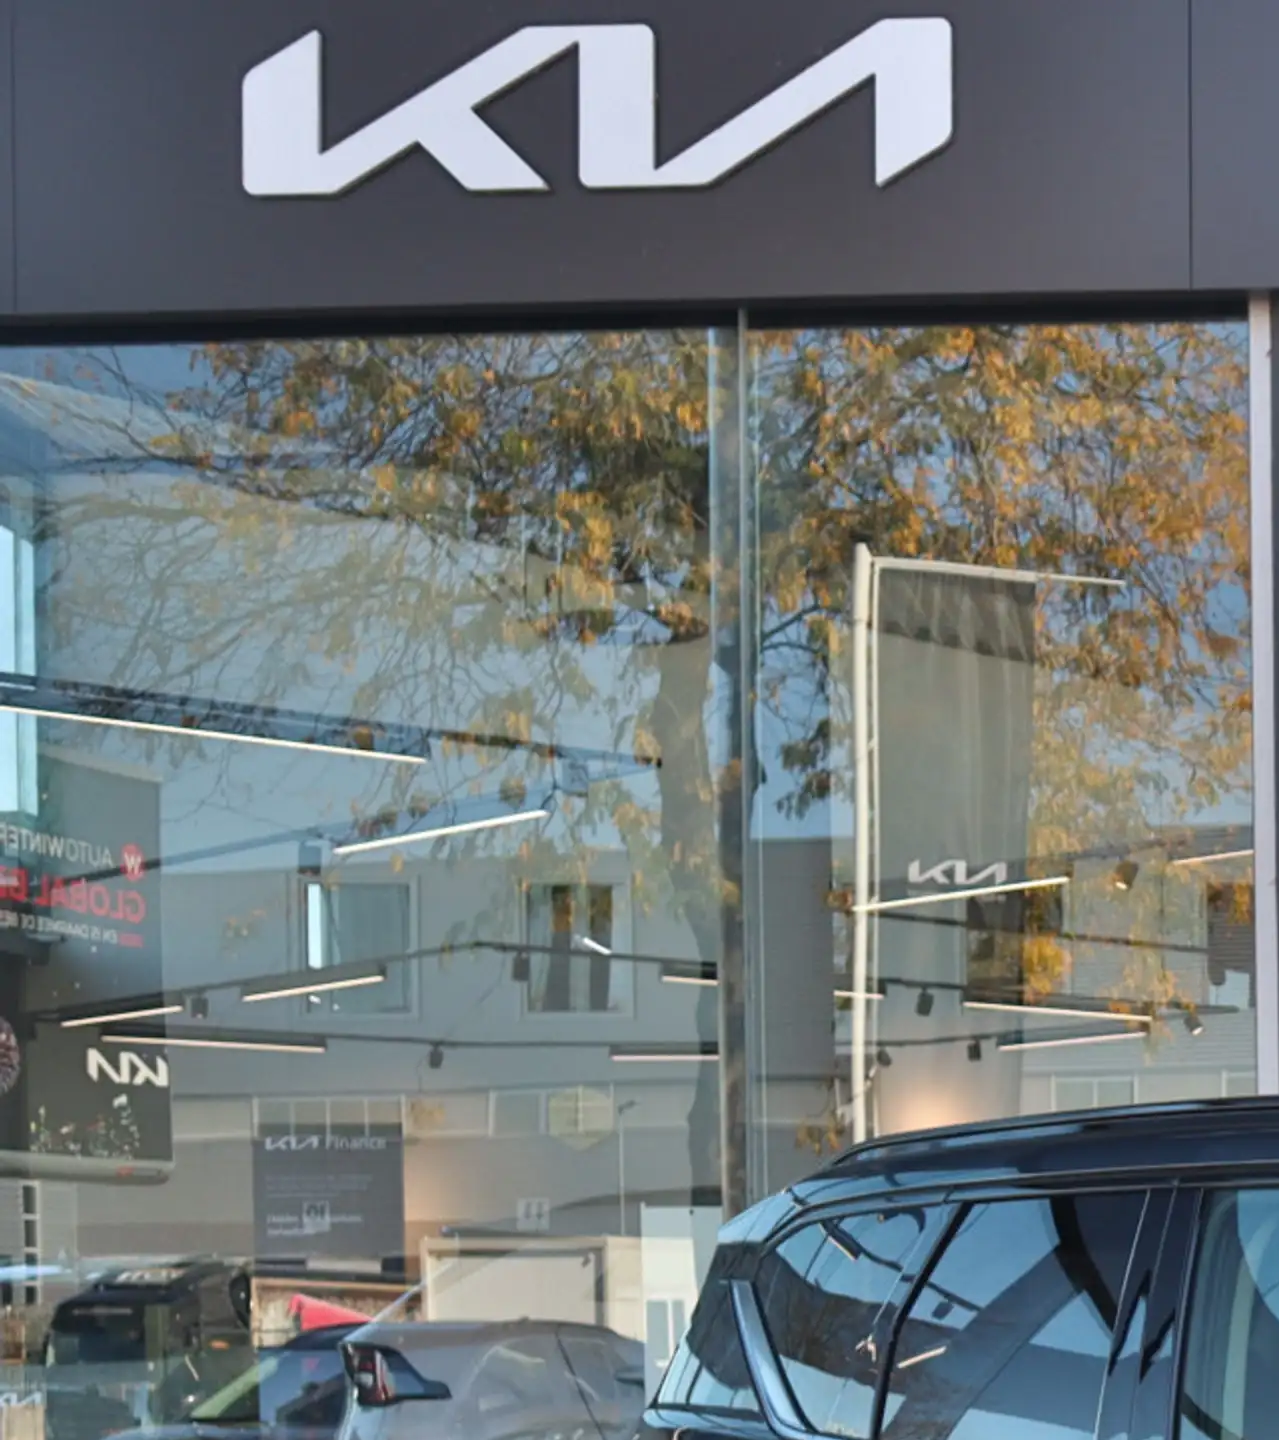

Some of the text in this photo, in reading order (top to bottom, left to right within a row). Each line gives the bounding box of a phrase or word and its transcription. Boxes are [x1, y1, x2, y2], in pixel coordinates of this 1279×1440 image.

[242, 17, 953, 196] KIA
[908, 859, 1007, 886] KIA
[265, 1135, 387, 1150] KIA Finance
